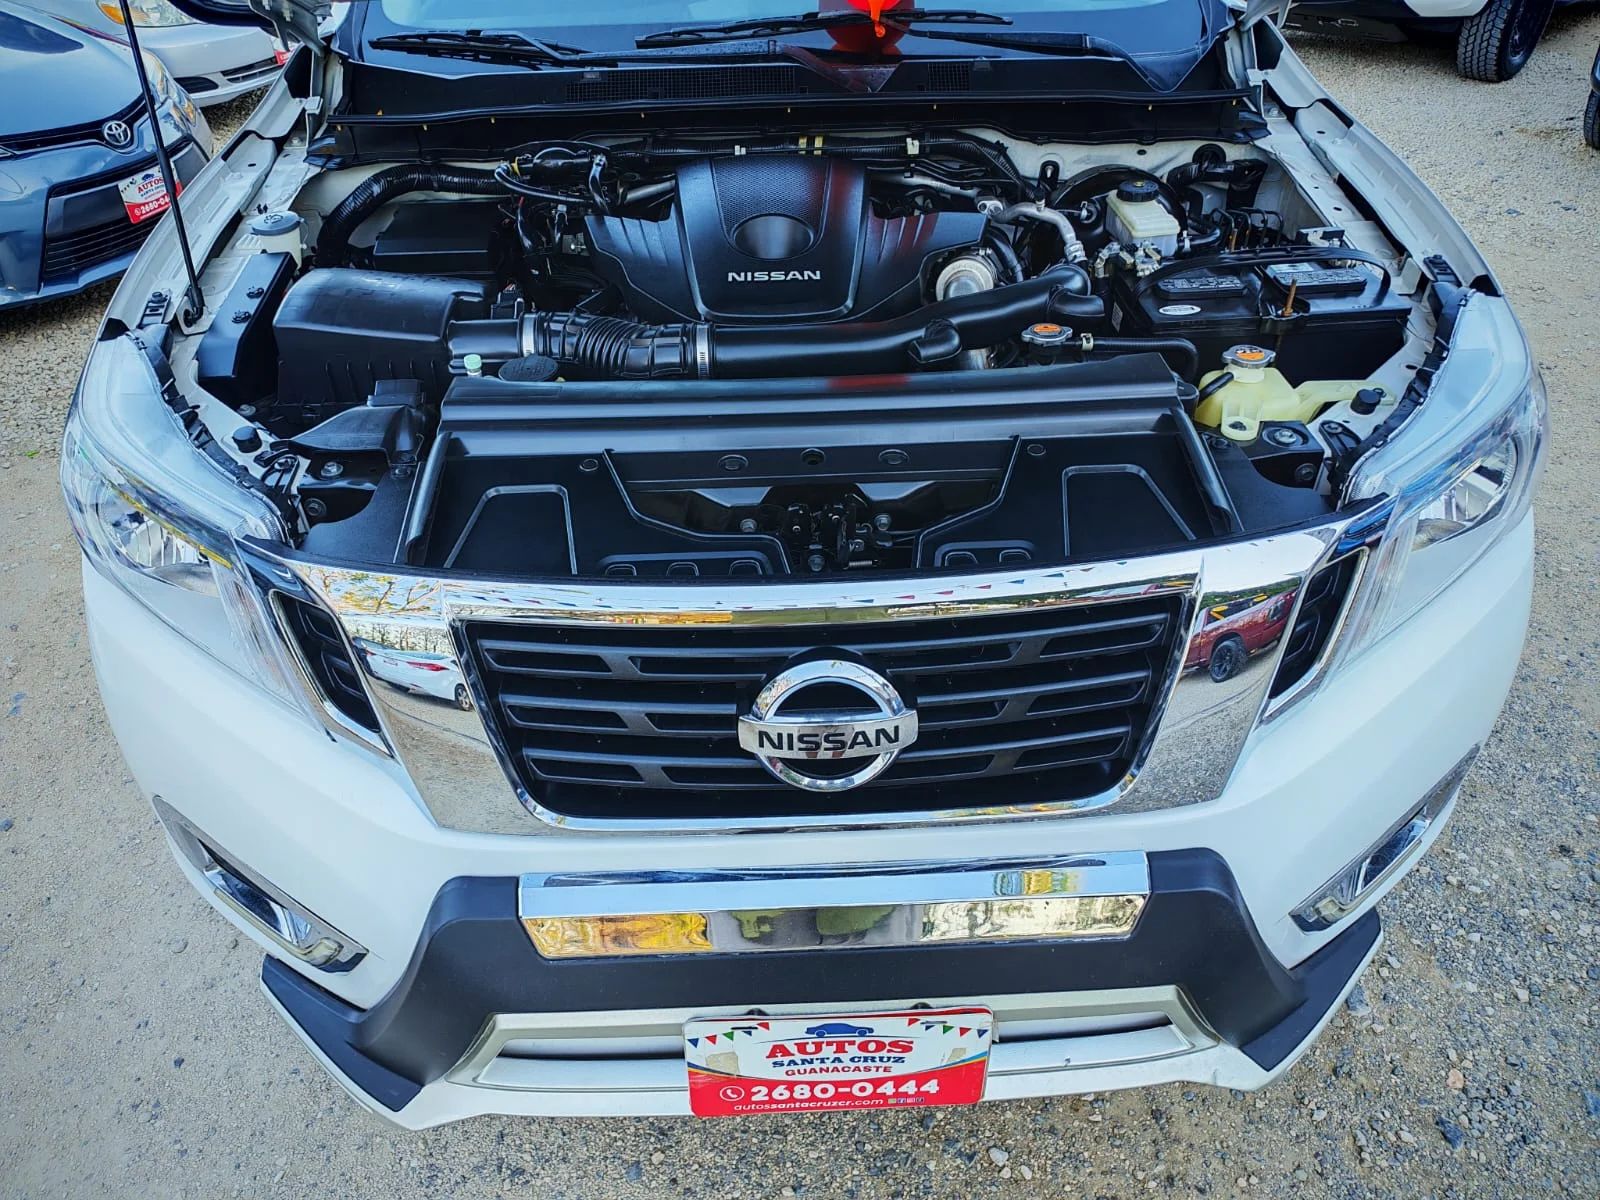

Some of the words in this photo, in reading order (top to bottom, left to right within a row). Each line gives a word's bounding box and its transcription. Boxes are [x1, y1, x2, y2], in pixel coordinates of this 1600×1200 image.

[727, 270, 821, 282] NISSAN
[758, 725, 900, 752] NISSAN
[765, 1039, 914, 1059] AUTOS
[772, 1056, 844, 1068] SANTA
[848, 1055, 906, 1064] CRUZ
[784, 1065, 893, 1077] GUANACASTE
[751, 1078, 940, 1102] 2680-0444
[733, 1098, 884, 1112] autossantacruzcr.com
